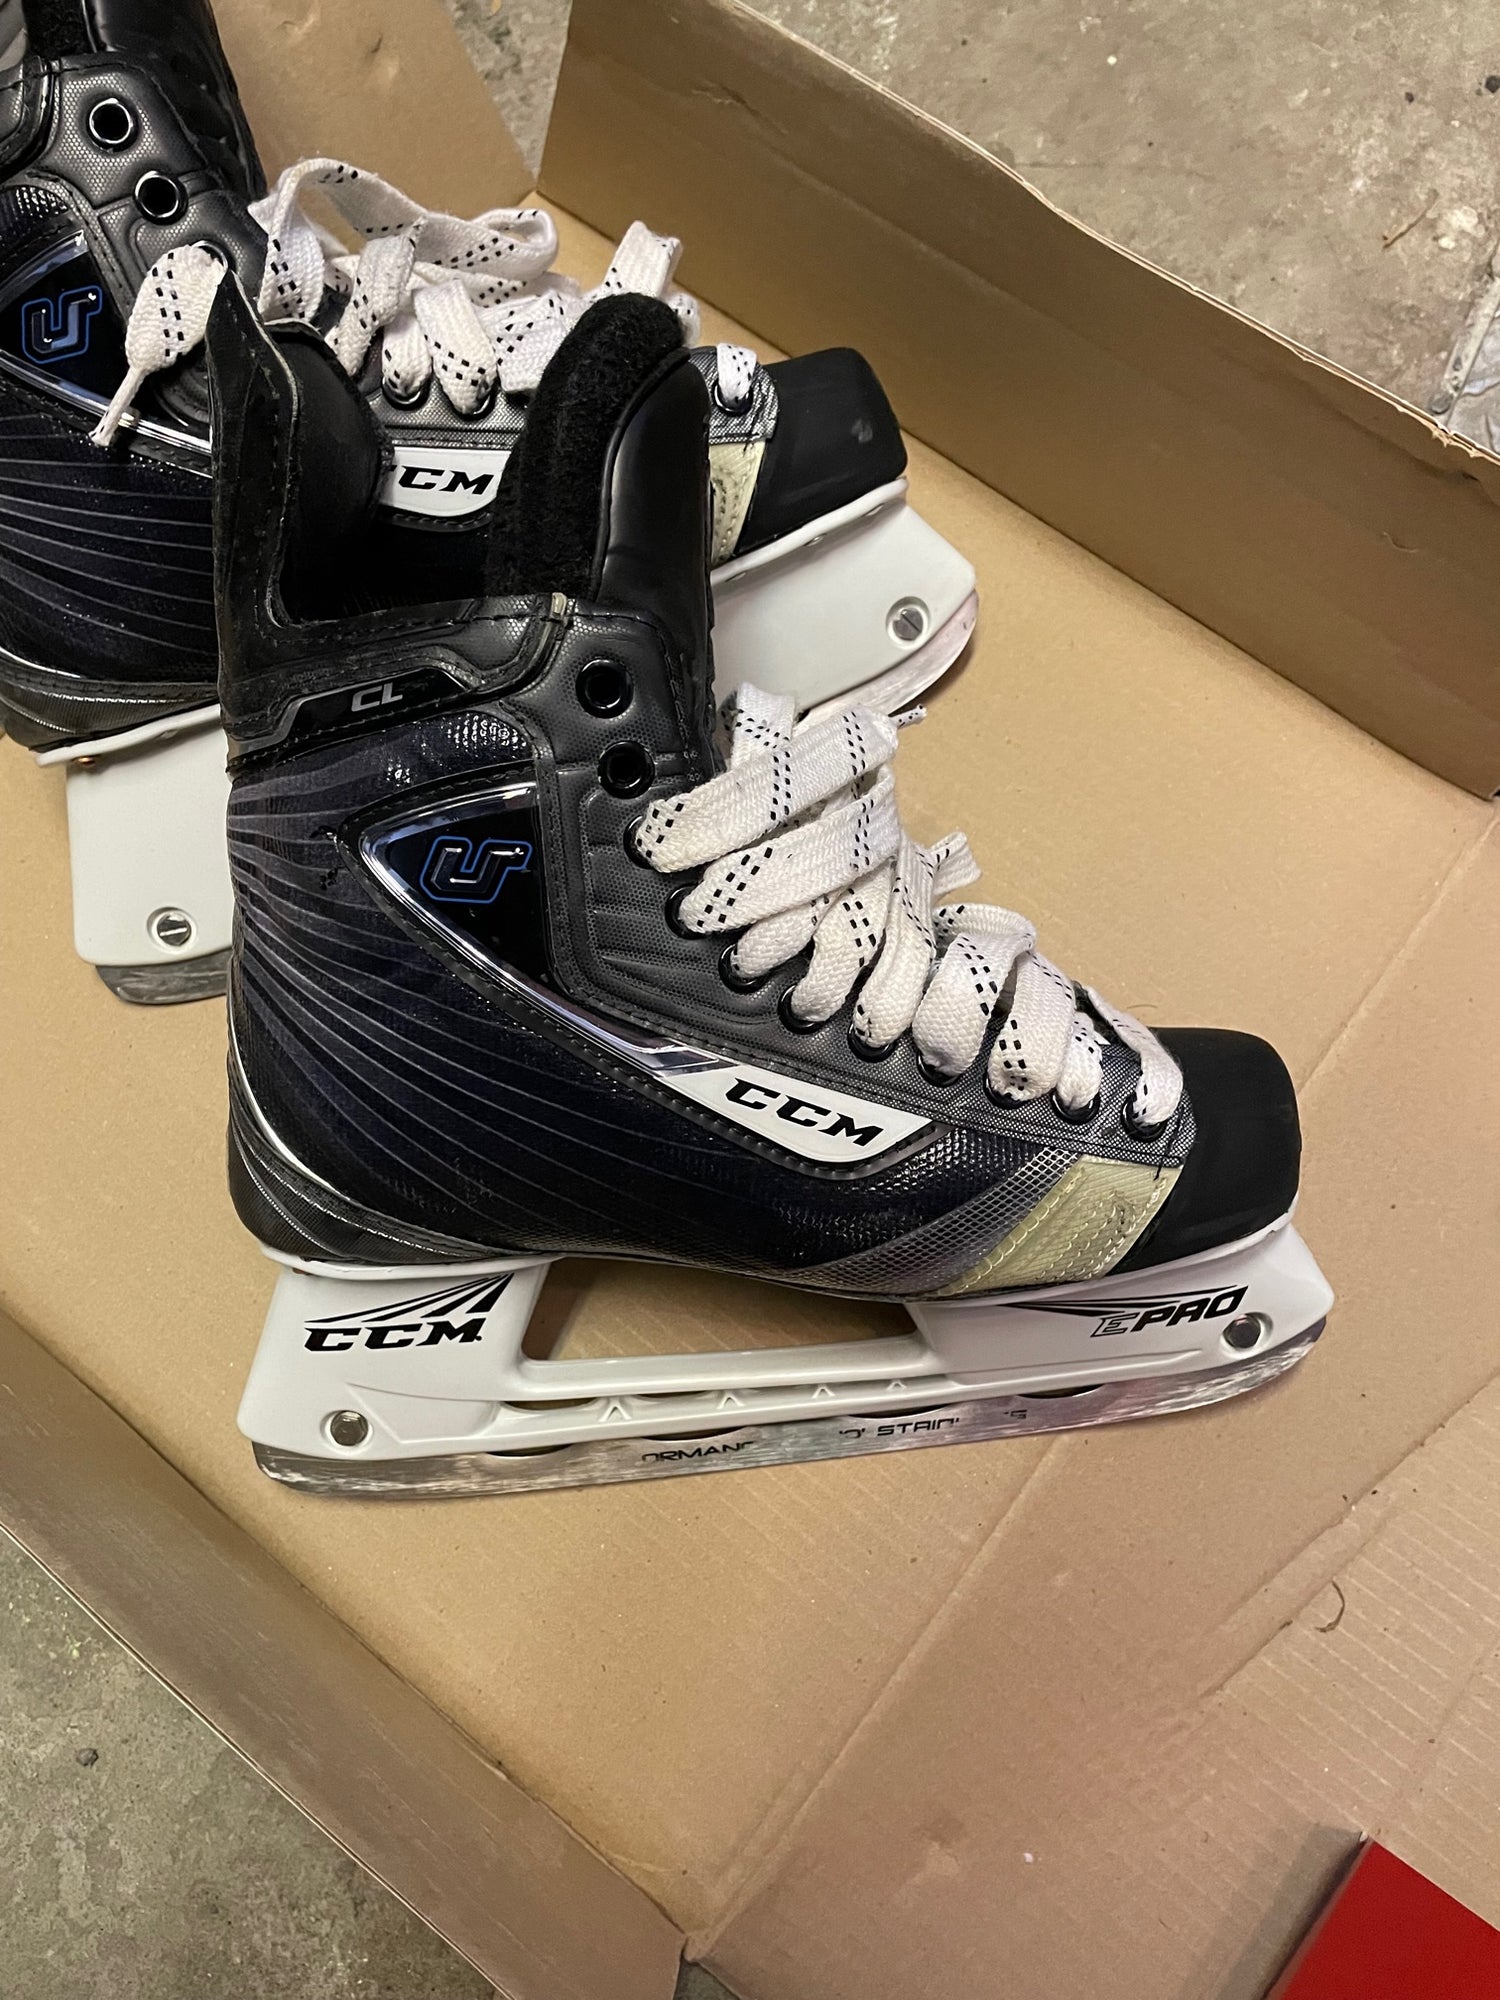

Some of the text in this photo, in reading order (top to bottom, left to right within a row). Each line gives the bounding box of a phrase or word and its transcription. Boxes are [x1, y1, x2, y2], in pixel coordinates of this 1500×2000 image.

[390, 464, 494, 495] CM
[351, 682, 403, 712] CL
[725, 1077, 885, 1147] CCM
[304, 1318, 486, 1352] CCM
